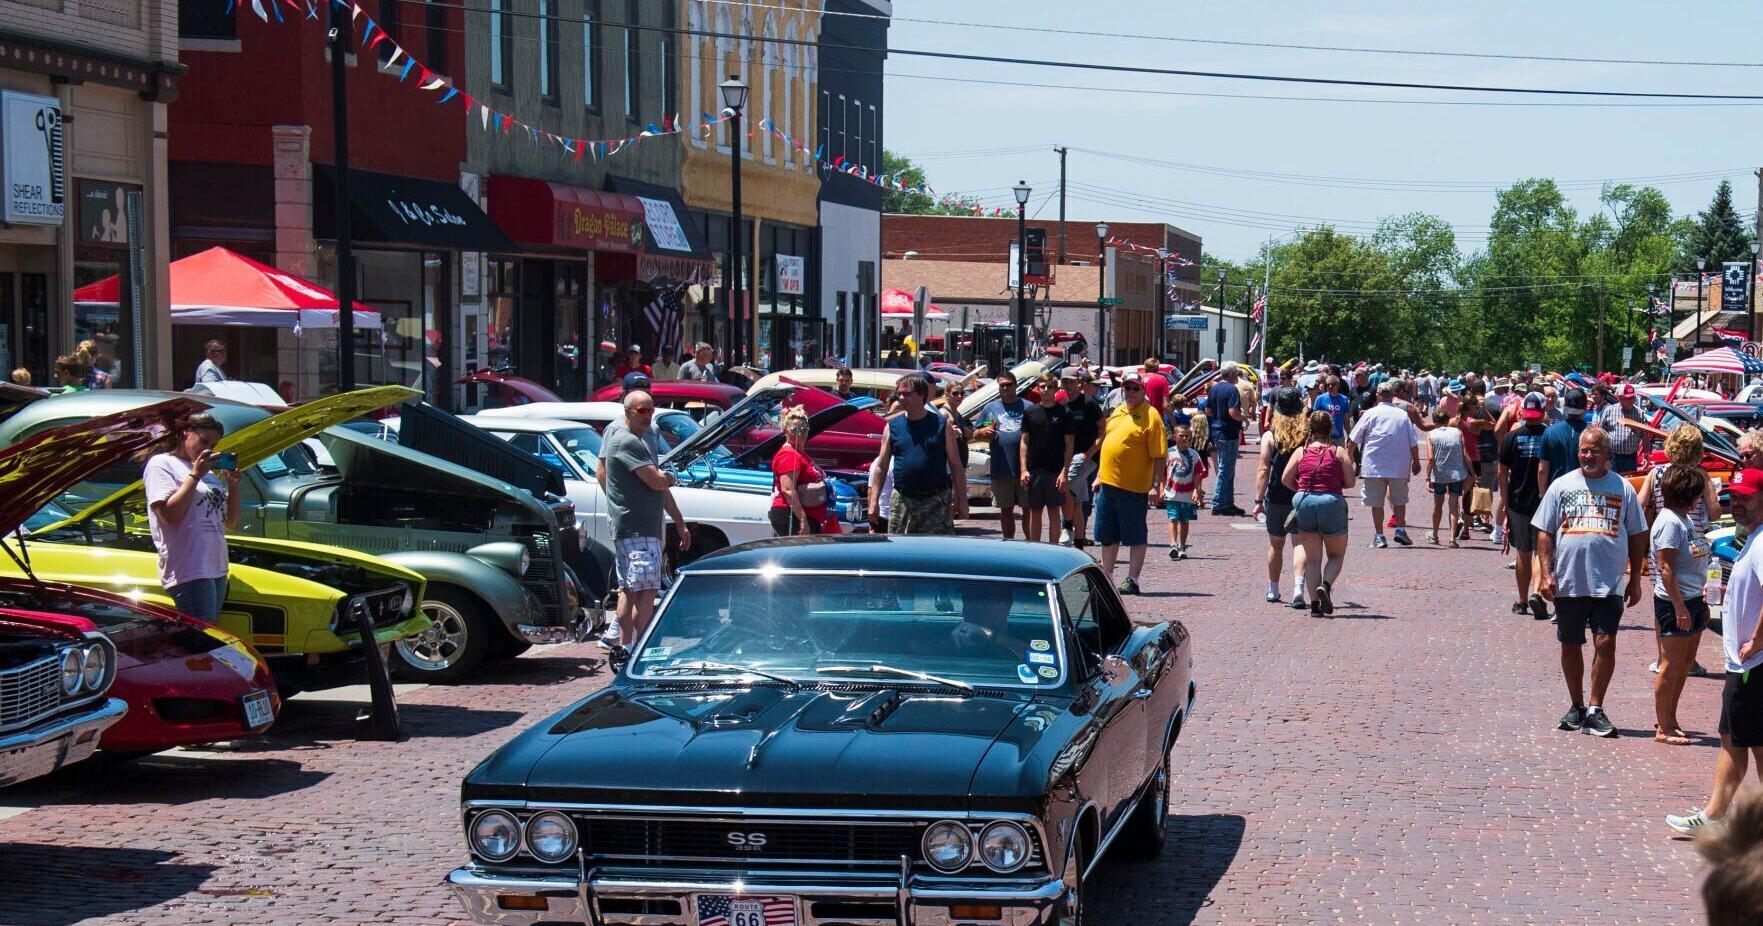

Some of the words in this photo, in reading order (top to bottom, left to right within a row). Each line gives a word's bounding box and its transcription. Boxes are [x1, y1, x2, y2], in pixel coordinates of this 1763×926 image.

[13, 183, 43, 200] SHEAR
[14, 201, 64, 216] REFLECTIONS
[574, 208, 602, 240] Dragon
[604, 213, 628, 239] Palace
[1576, 494, 1607, 506] ALEXA
[1600, 506, 1618, 520] THE
[1567, 517, 1614, 530] PRESIDENT
[727, 832, 767, 845] SS
[735, 912, 760, 926] 66
